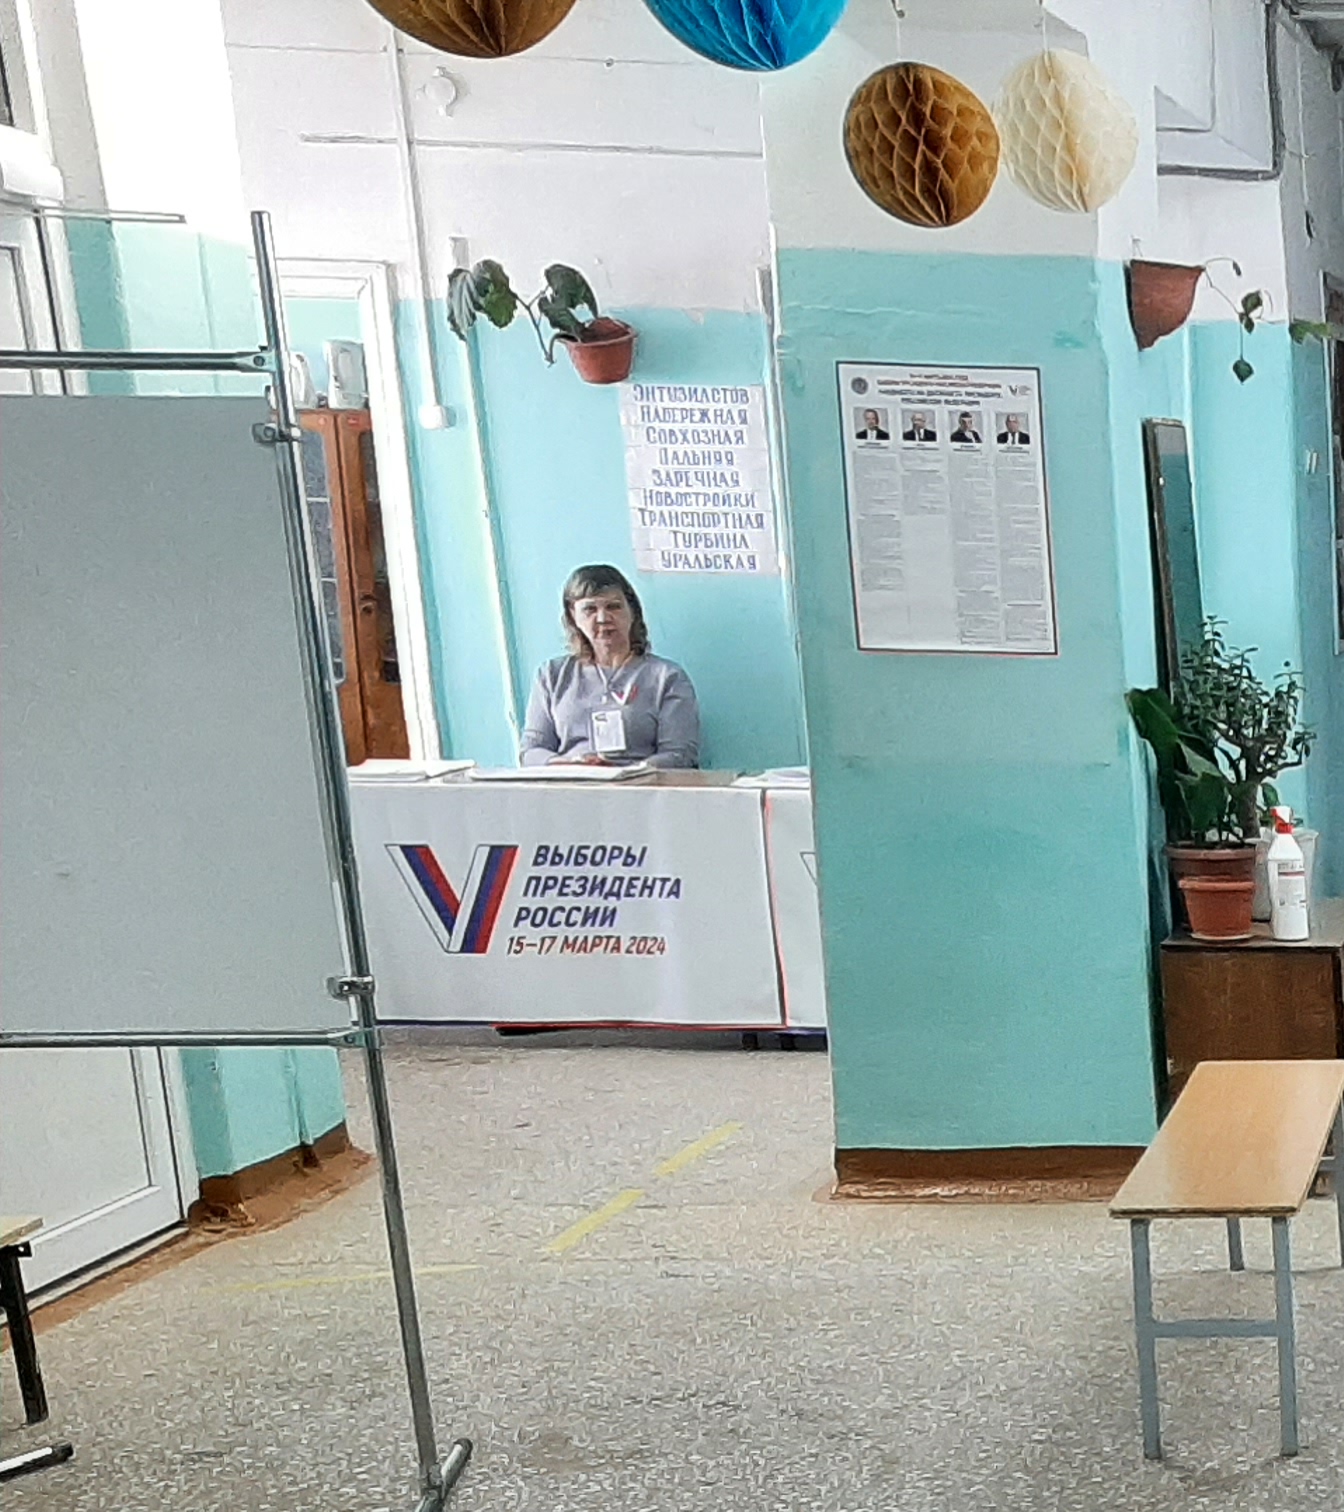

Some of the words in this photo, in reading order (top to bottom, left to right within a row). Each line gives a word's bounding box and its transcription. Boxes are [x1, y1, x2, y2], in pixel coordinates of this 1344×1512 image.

[633, 384, 750, 404] ЭНТУЗИАСТОВ
[640, 405, 749, 425] НАБЕРЕЖНАЯ
[646, 426, 745, 445] СОВХОЗНАЯ
[651, 468, 741, 488] ЗАРЕЧНАЯ
[638, 508, 765, 530] ТРАНСПОРТНАЯ
[670, 530, 751, 549] ТУРБИНА
[661, 551, 758, 570] УРАЛЬСКАЯ
[532, 844, 648, 868] ВЫБОРЫ
[522, 875, 682, 901] ПРЕЗИДЕНТА
[513, 906, 618, 929] РОССИИ
[559, 935, 622, 955] МАРТА
[625, 936, 666, 956] 2024
